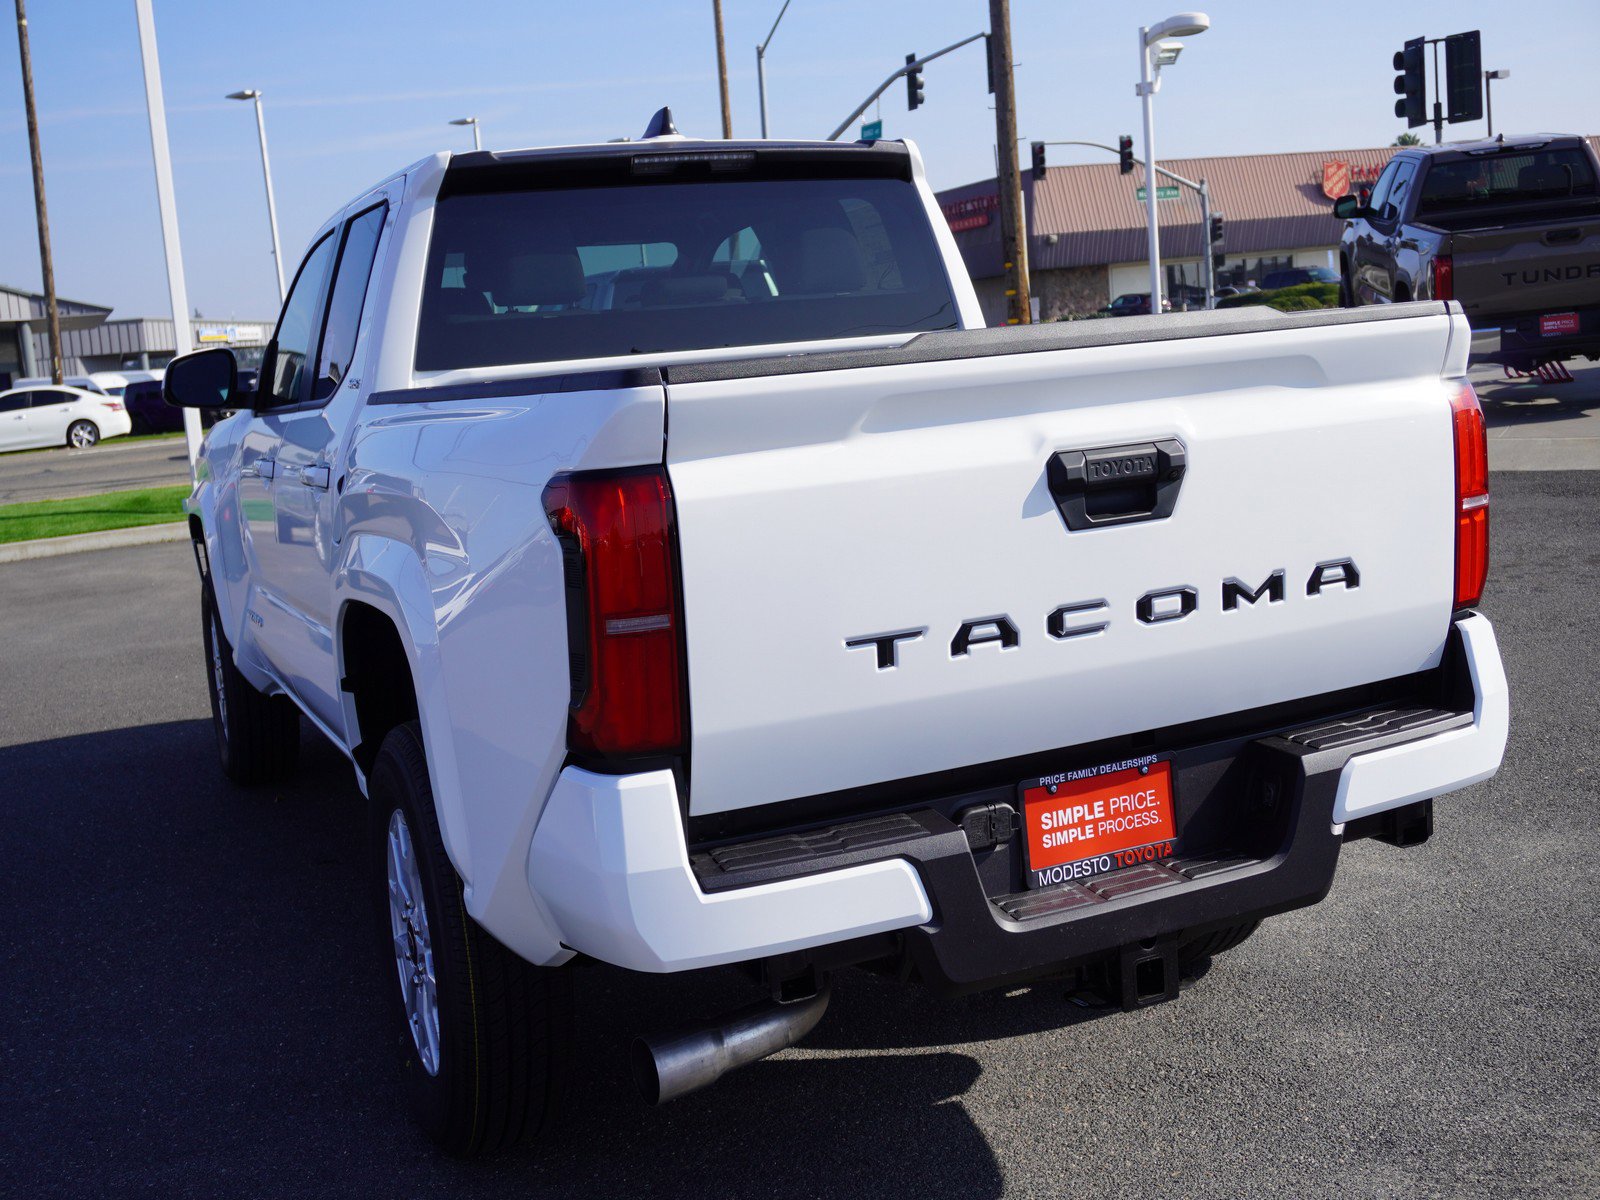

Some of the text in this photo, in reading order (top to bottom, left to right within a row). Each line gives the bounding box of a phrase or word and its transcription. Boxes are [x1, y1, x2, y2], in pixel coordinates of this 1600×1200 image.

[1090, 456, 1155, 478] TOYOTA
[844, 556, 1360, 671] TACOMA
[1039, 755, 1157, 786] PRICE FAMILY DEALERSHIPS
[1041, 801, 1105, 830] SIMPLE
[1109, 790, 1160, 814] PRICE.
[1042, 810, 1162, 848] SIMPLE PROCESS.
[1038, 842, 1173, 887] MODESTO TOYOTA
